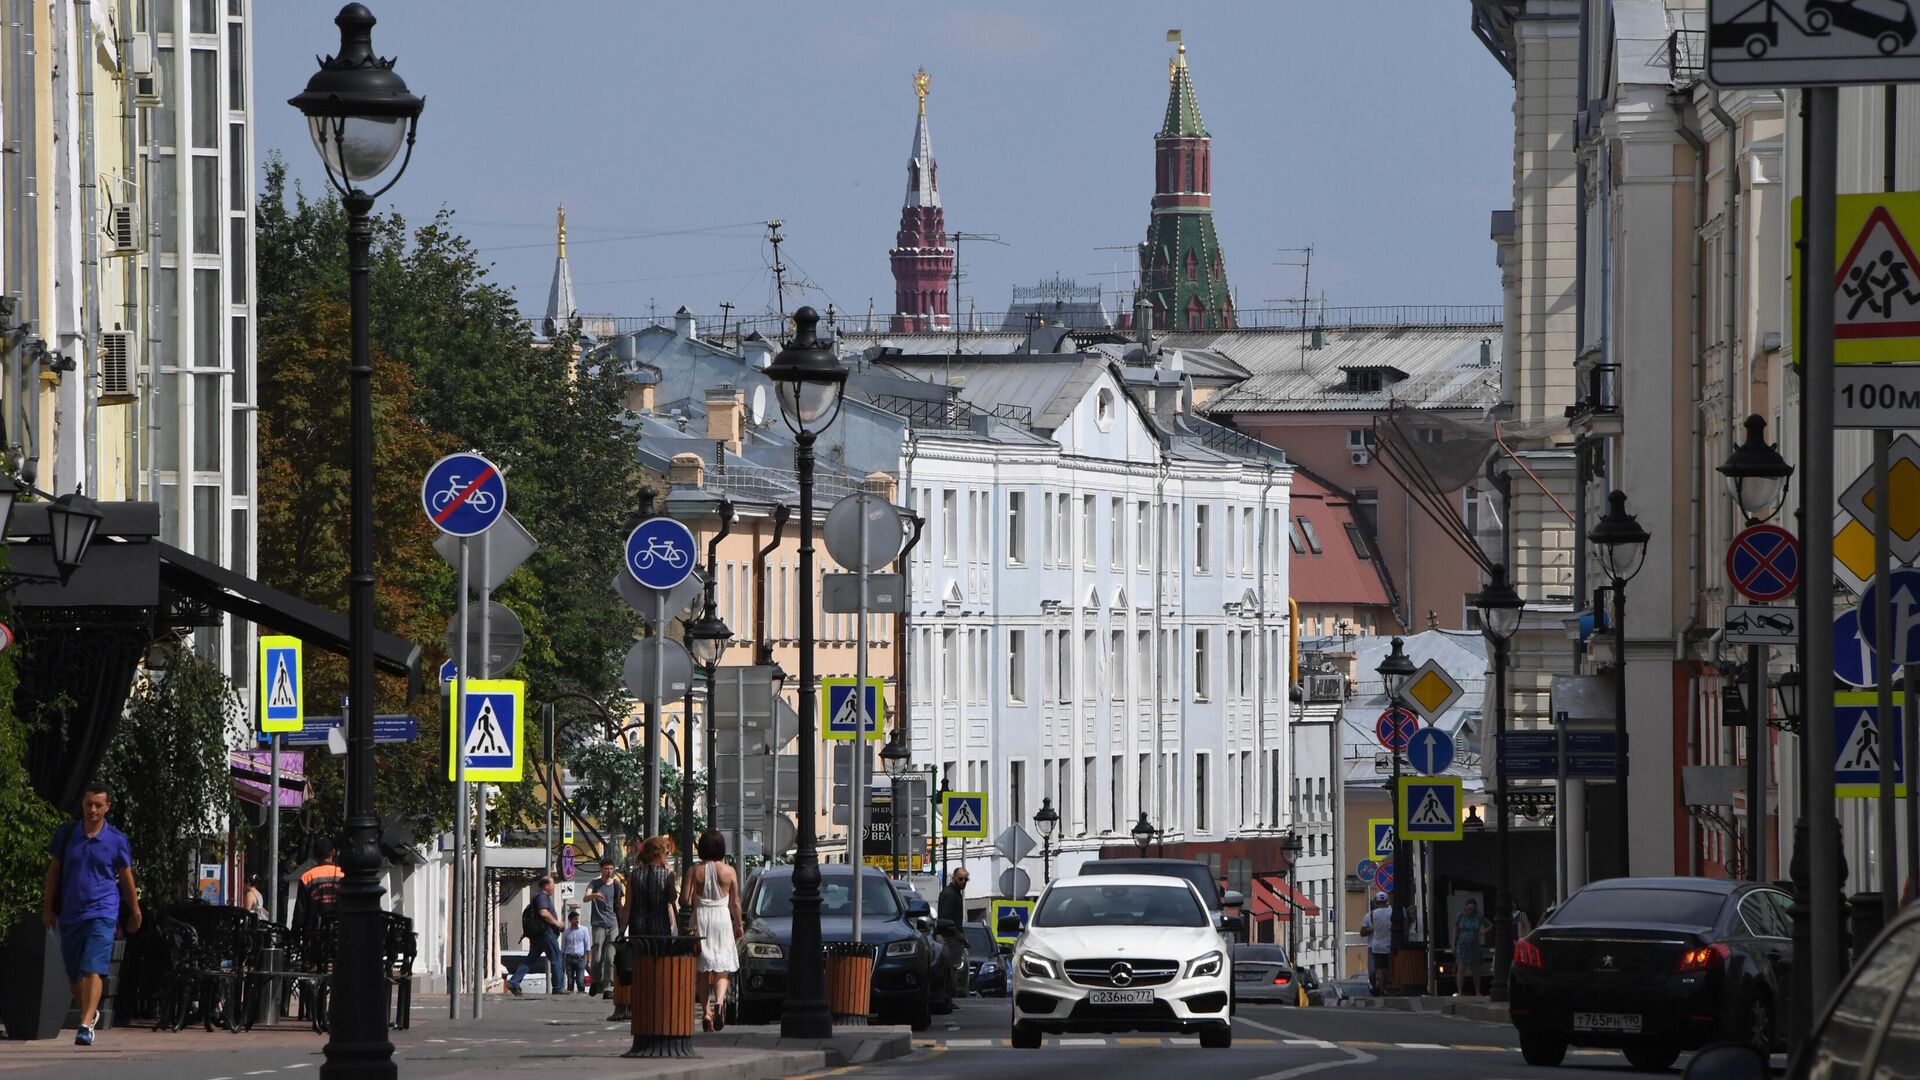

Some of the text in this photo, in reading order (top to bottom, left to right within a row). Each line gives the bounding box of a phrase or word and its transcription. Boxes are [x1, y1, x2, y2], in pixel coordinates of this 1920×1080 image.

[1841, 383, 1920, 409] 100м
[1135, 990, 1151, 999] 777
[1622, 1014, 1639, 1025] 190
